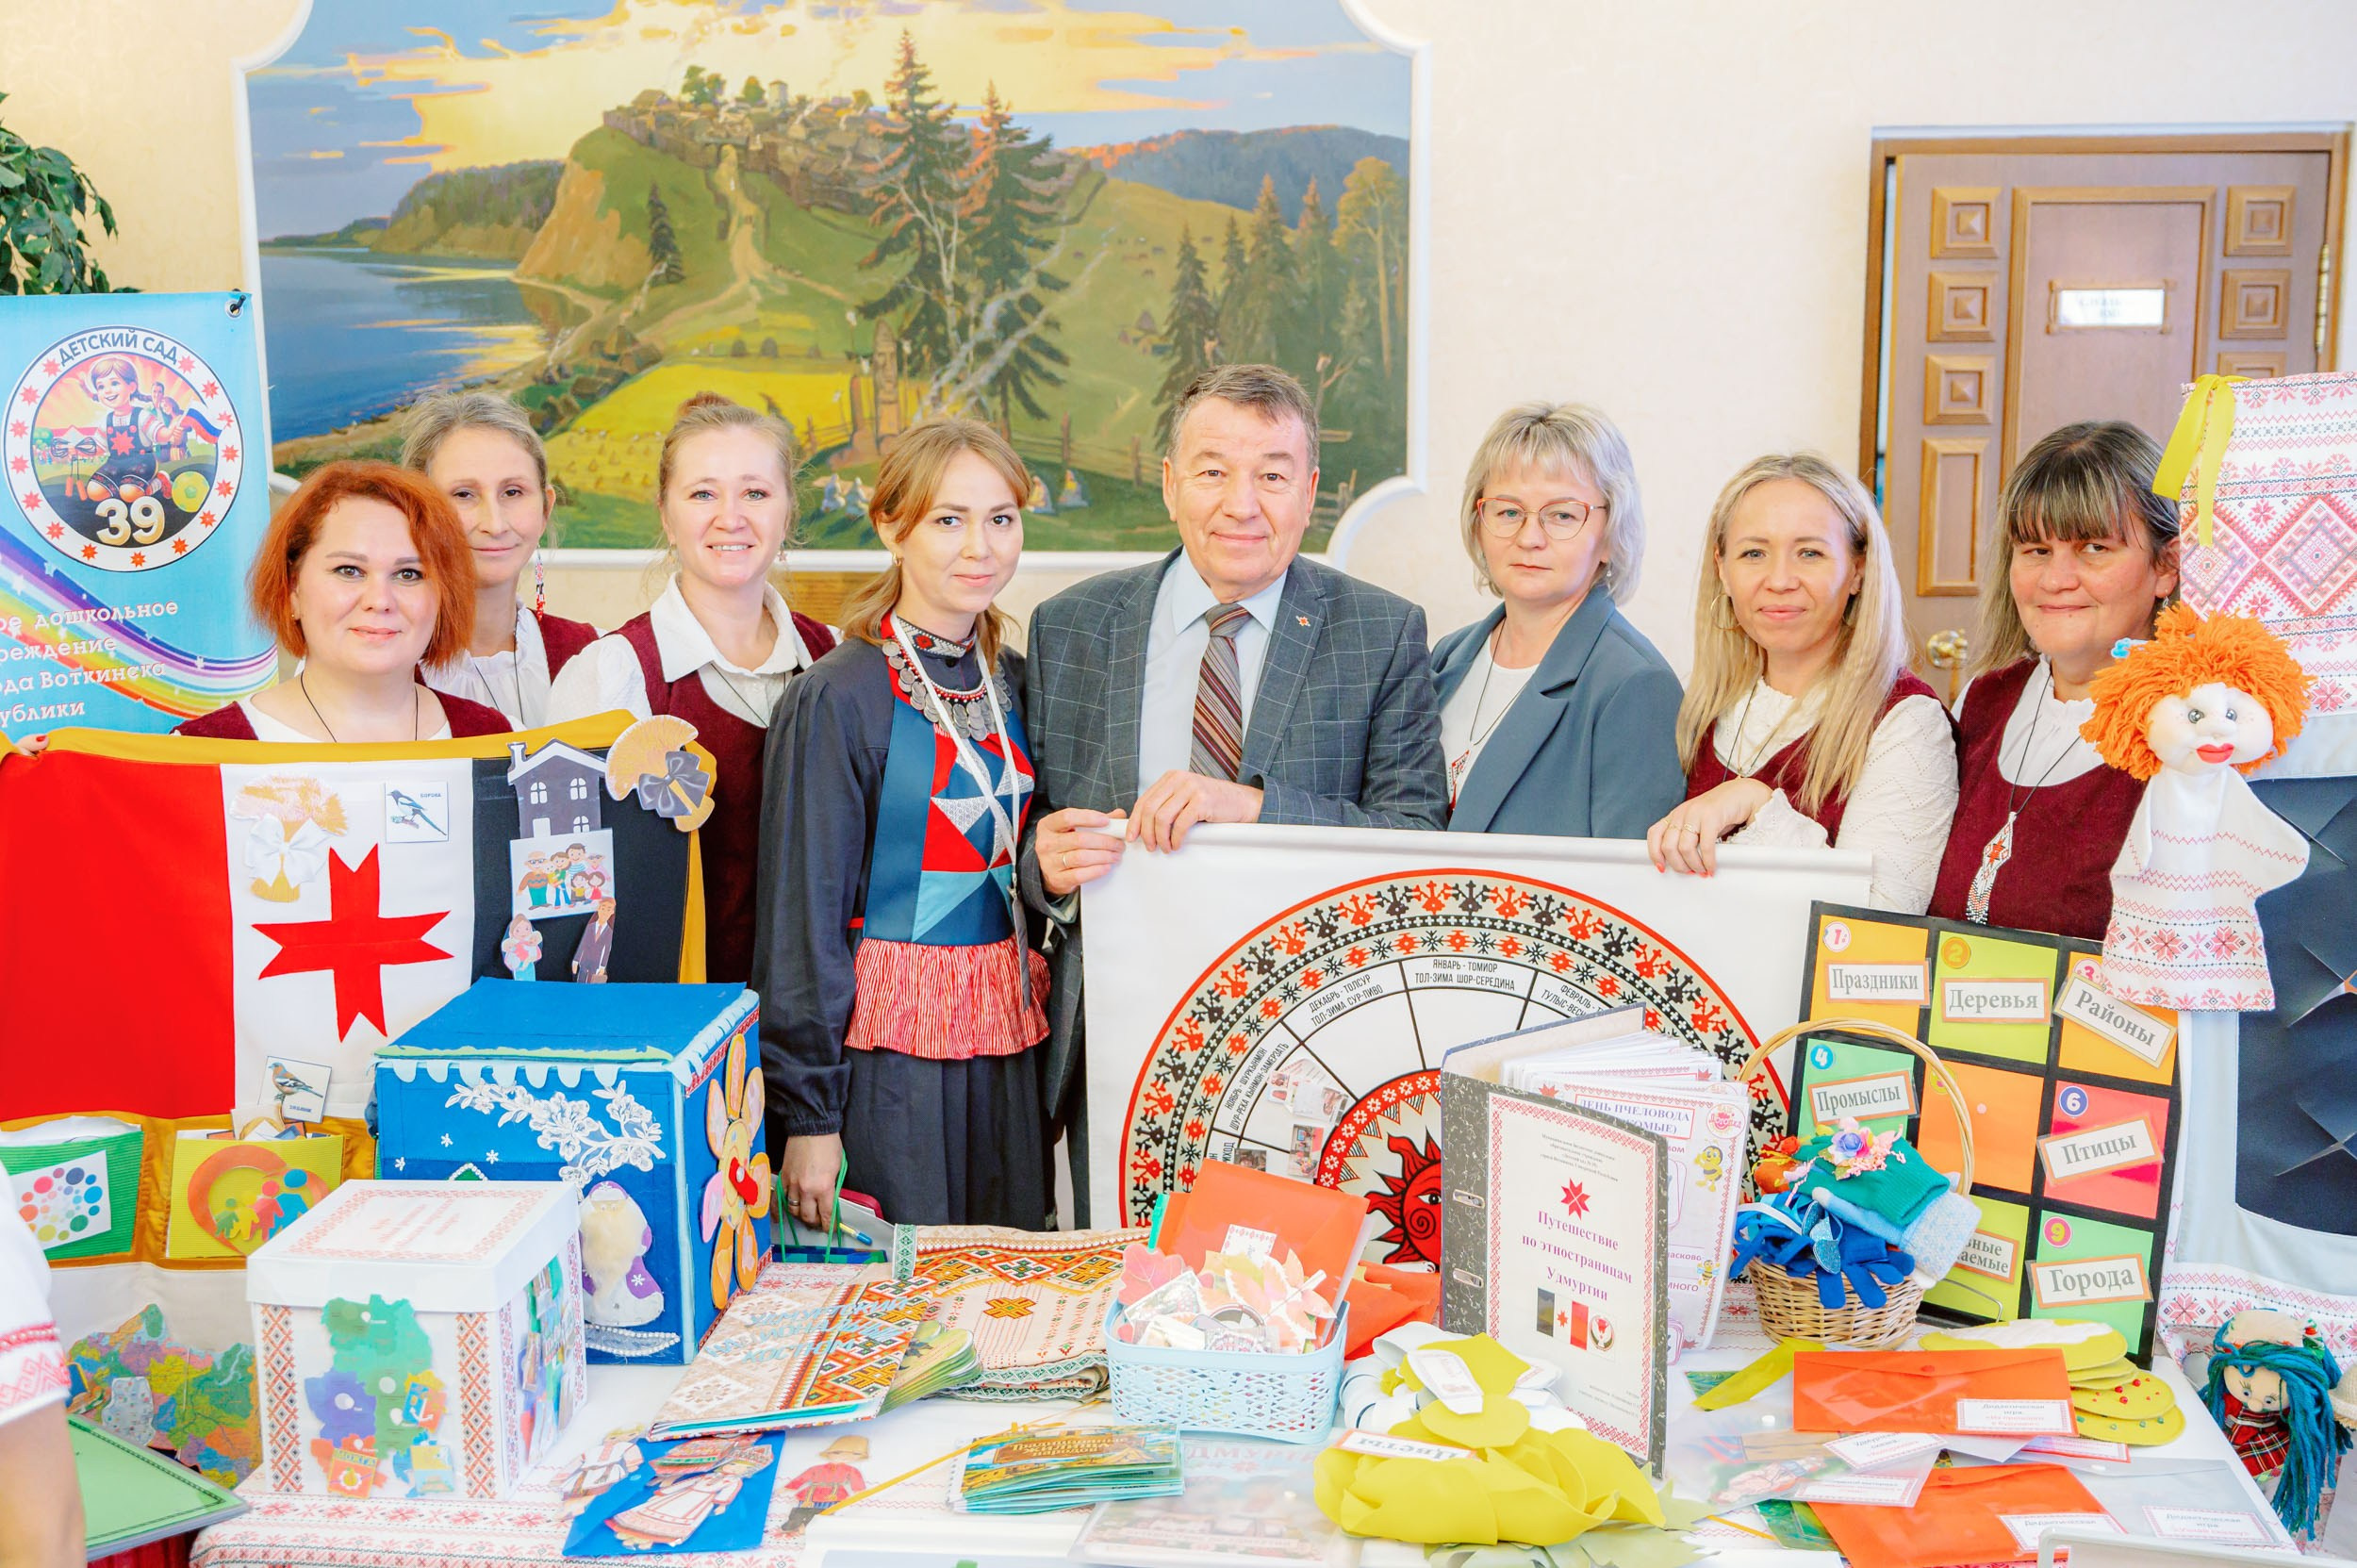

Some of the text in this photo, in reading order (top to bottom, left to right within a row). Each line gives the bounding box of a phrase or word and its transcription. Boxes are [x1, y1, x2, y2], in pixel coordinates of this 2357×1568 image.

[59, 329, 178, 367] ДЕТСКИЙ САД
[95, 496, 166, 546] 39
[34, 602, 178, 630] дошкольное
[0, 662, 166, 696] да Воткинска
[1834, 929, 1842, 945] 1
[1432, 958, 1461, 970] ЯНВАРЬ
[1468, 961, 1498, 973] ТОМИОР
[1948, 943, 1964, 963] 2
[1309, 989, 1341, 1013] ДЕКАБРЬ
[1343, 974, 1371, 994] ТОЛСУР
[1415, 972, 1515, 991] ТОЛ-ЗИМА ШОР-СЕРЕДИНА
[1832, 968, 1920, 995] Праздники
[1310, 984, 1384, 1026] ТОЛ-ЗИМА СУР-ПИВО
[1541, 989, 1587, 1016] ТУЛЫС-ВЕСН
[1560, 984, 1591, 1009] ФЕВРАЛЬ
[1949, 989, 2038, 1014] Деревья
[2074, 989, 2156, 1047] Районы
[1815, 1048, 1828, 1066] 4
[1225, 1087, 1242, 1111] НОЯБРЬ
[1240, 1048, 1267, 1085] ШУРКЫНМОН
[1229, 1042, 1290, 1131] ШУР-РЕКА КЫНМОН-ЗАМЕРЗАТЬ
[1615, 1104, 1690, 1122] ПЧЕЛОВОДА
[1816, 1086, 1902, 1116] Промыслы
[2066, 1092, 2081, 1112] 6
[1626, 1118, 1678, 1134] КОМЫЕ)
[2061, 1134, 2137, 1164] Птицы
[1538, 1210, 1619, 1250] Путешествие
[2051, 1223, 2066, 1243] 9
[1522, 1235, 1633, 1284] по этностраницам
[1957, 1250, 2009, 1273] аемые
[1546, 1265, 1608, 1301] Удмуртии
[2050, 1268, 2135, 1297] Города
[742, 1338, 855, 1363] КОСТЮМ
[1358, 1438, 1458, 1460] Цветы
